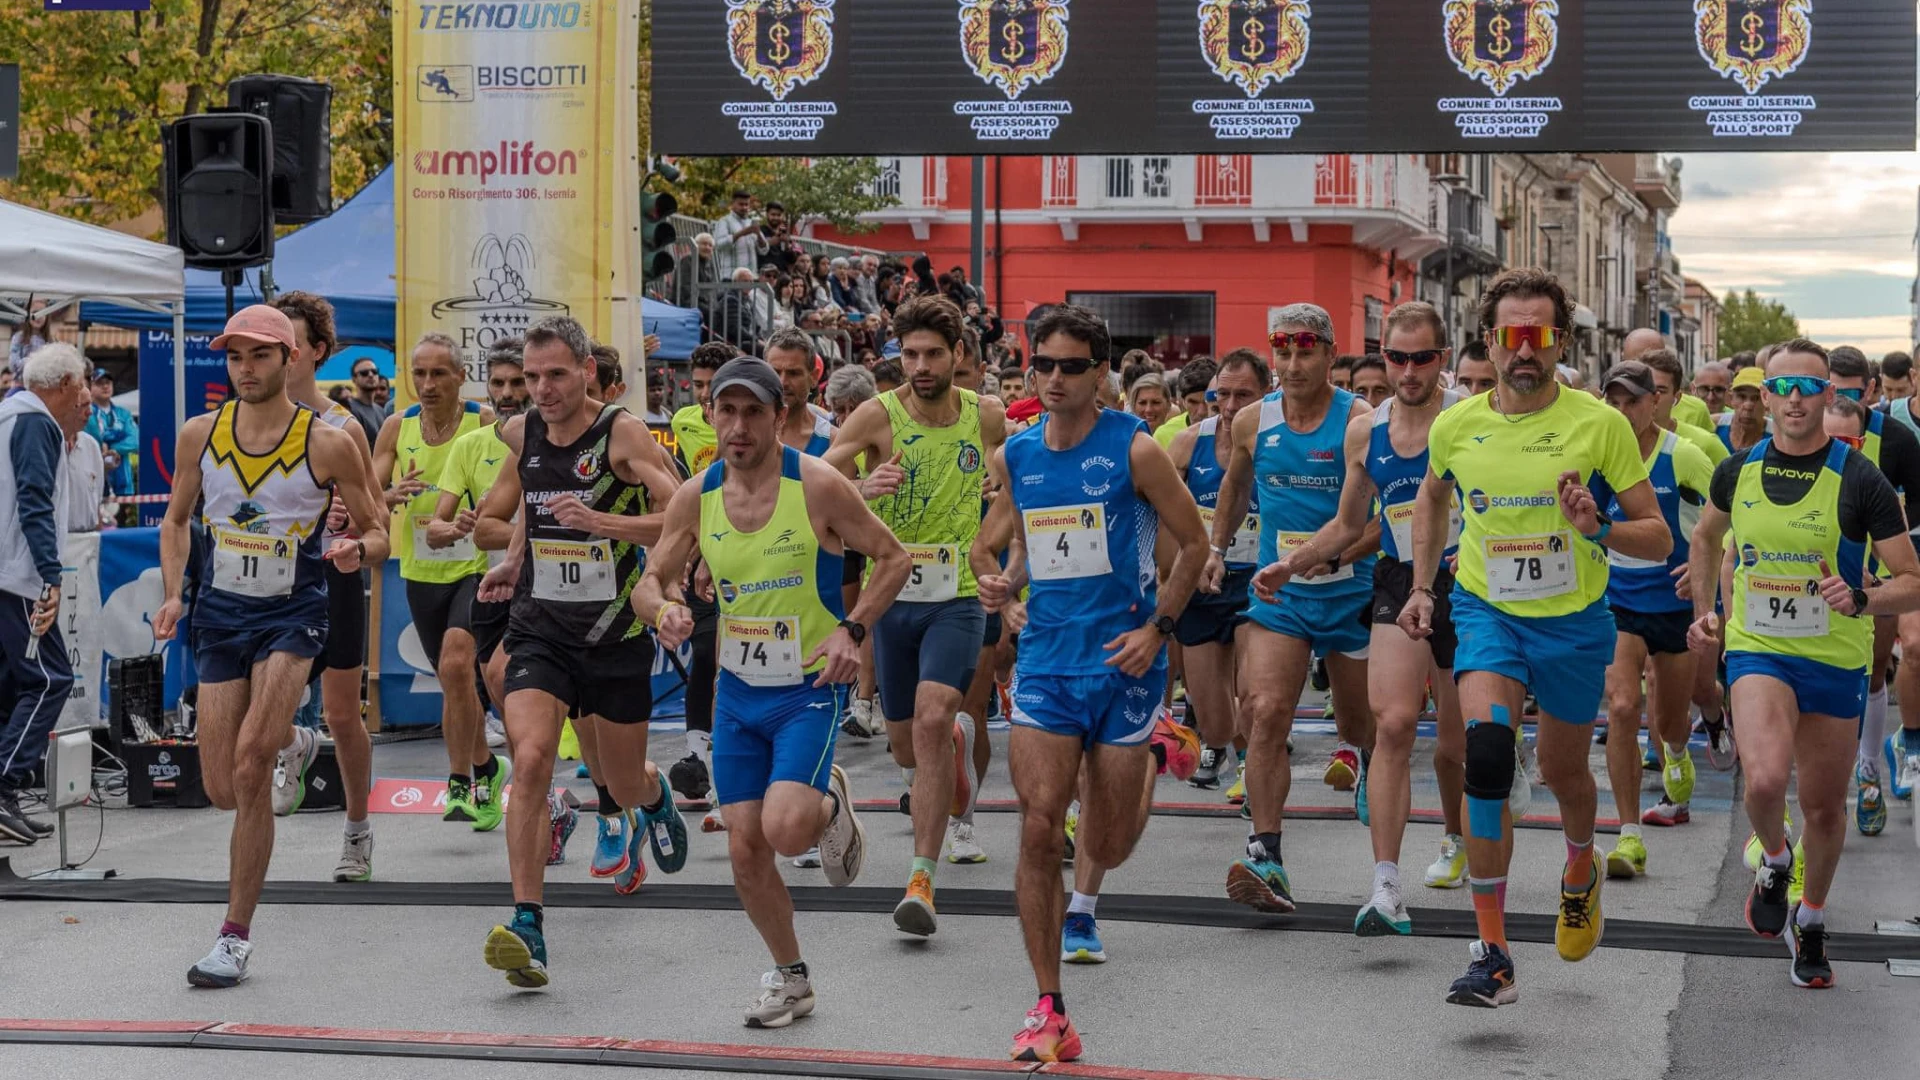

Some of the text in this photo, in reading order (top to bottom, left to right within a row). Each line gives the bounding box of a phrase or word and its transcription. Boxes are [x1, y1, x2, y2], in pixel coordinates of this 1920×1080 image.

[418, 3, 581, 30] TEKNOUNO
[478, 65, 586, 86] BISCOTTI
[956, 102, 1070, 112] COMUNE DI ISERNIA
[1194, 101, 1312, 111] COMUNE DI ISERNIA
[1439, 99, 1560, 109] COMUNE DI ISERNIA
[1691, 97, 1814, 107] COMUNE DI ISERNIA
[723, 104, 835, 113] COMUNE DI ISERNIA
[740, 119, 822, 128] ASSESSORATO
[972, 118, 1057, 127] ASSESSORATO
[1211, 116, 1299, 126] ASSESSORATO
[1457, 115, 1546, 124] ASSESSORATO
[1708, 113, 1800, 122] ASSESSORATO
[746, 129, 815, 138] ALLO SPORT
[979, 128, 1050, 137] ALLO SPORT
[1218, 127, 1291, 136] ALLO SPORT
[1464, 126, 1538, 135] ALLO SPORT
[1716, 124, 1792, 133] ALLO SPORT
[413, 140, 578, 185] amplifon
[412, 187, 577, 201] Corso Risorgimento 306, Isernia
[1081, 455, 1116, 471] ATLETICA
[1764, 466, 1816, 481] GIVOVA
[1290, 474, 1339, 487] BISCOTTI
[1491, 495, 1555, 507] SCARABEO
[1031, 514, 1077, 528] corrisernia
[224, 538, 270, 551] corrisernia
[1056, 532, 1070, 557] 4
[1492, 541, 1545, 553] corrisernia
[539, 547, 586, 557] corrisernia
[242, 555, 259, 579] 11
[559, 562, 581, 584] 10
[1513, 557, 1543, 582] 78
[911, 564, 923, 585] 5
[739, 575, 803, 595] SCARABEO
[1753, 581, 1802, 592] corrisernia
[1769, 596, 1798, 620] 94
[729, 624, 769, 636] corrisernia
[740, 641, 768, 667] 74
